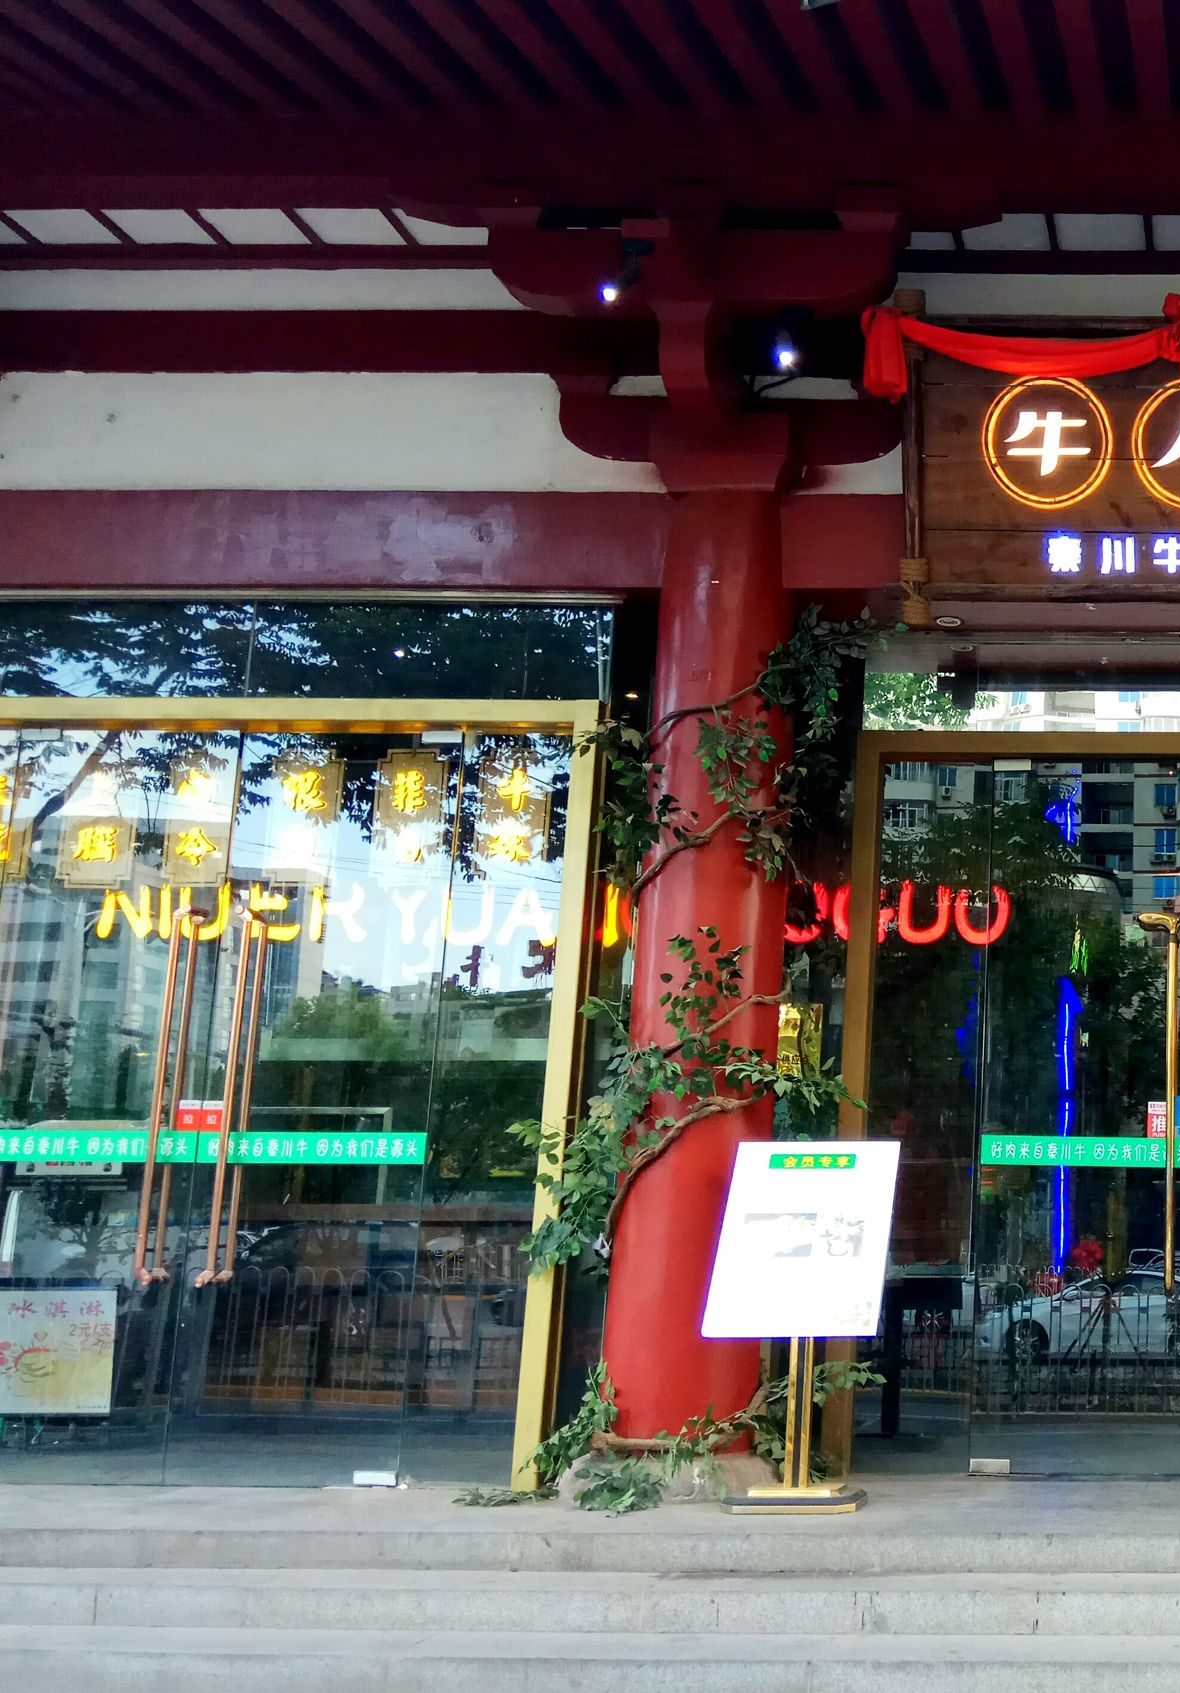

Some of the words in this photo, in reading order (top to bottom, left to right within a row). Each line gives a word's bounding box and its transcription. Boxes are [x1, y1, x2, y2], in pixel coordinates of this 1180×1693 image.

[96, 882, 618, 949] NIUERYUA
[1152, 1115, 1167, 1133] 推
[87, 1137, 188, 1156] 因为我们源头
[316, 1138, 418, 1158] 因为我们是源头
[990, 1142, 1086, 1160] 好肉来自秦川牛
[8, 1299, 105, 1319] 冰淇淋
